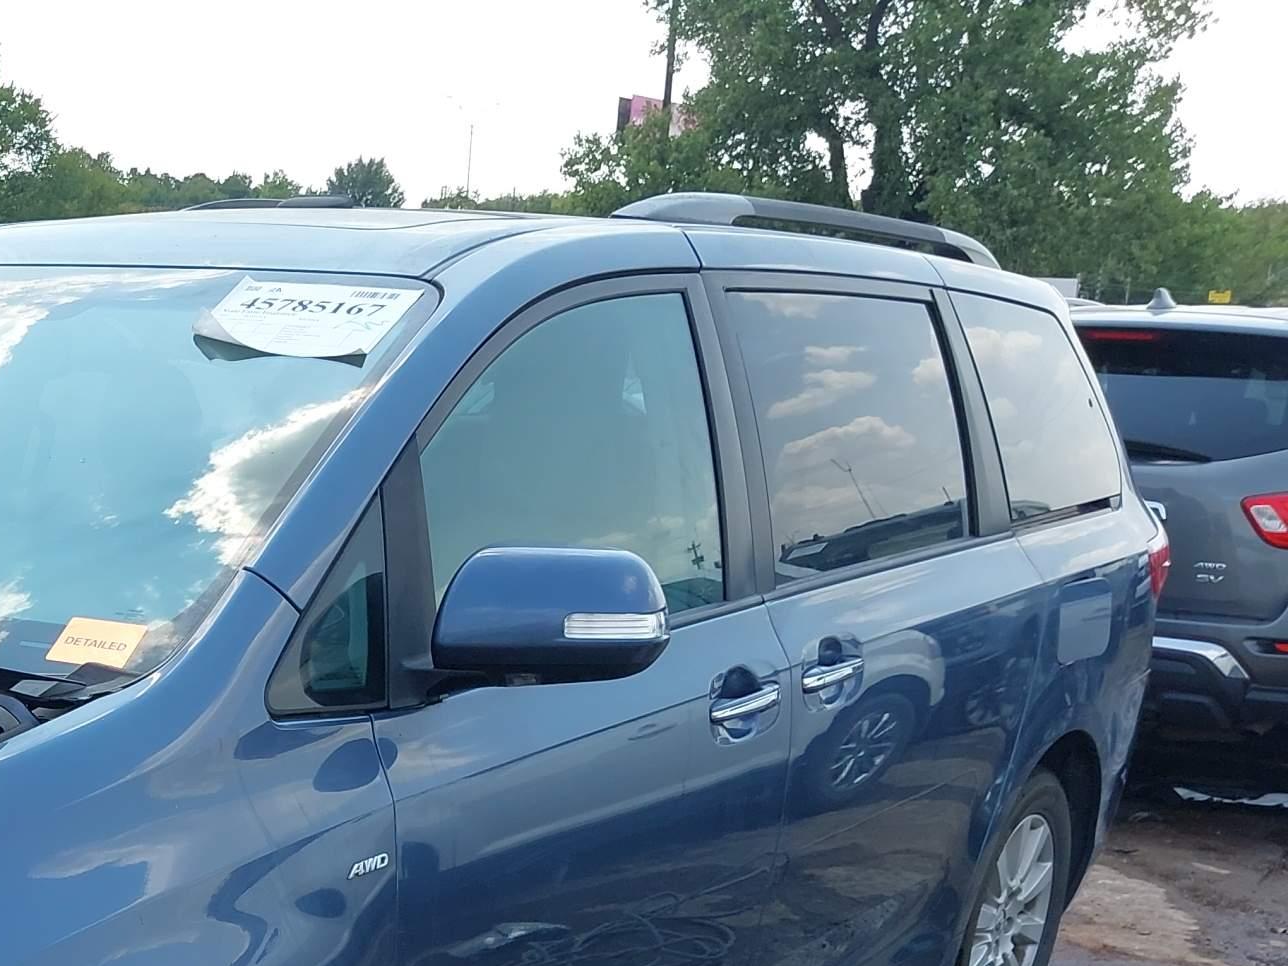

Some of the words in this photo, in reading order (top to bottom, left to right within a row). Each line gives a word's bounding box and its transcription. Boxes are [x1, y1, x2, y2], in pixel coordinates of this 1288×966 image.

[240, 296, 387, 317] 45785167
[1193, 561, 1227, 569] AWD
[1195, 573, 1225, 583] SV
[64, 636, 127, 651] DETAILED
[347, 853, 389, 880] AWD
